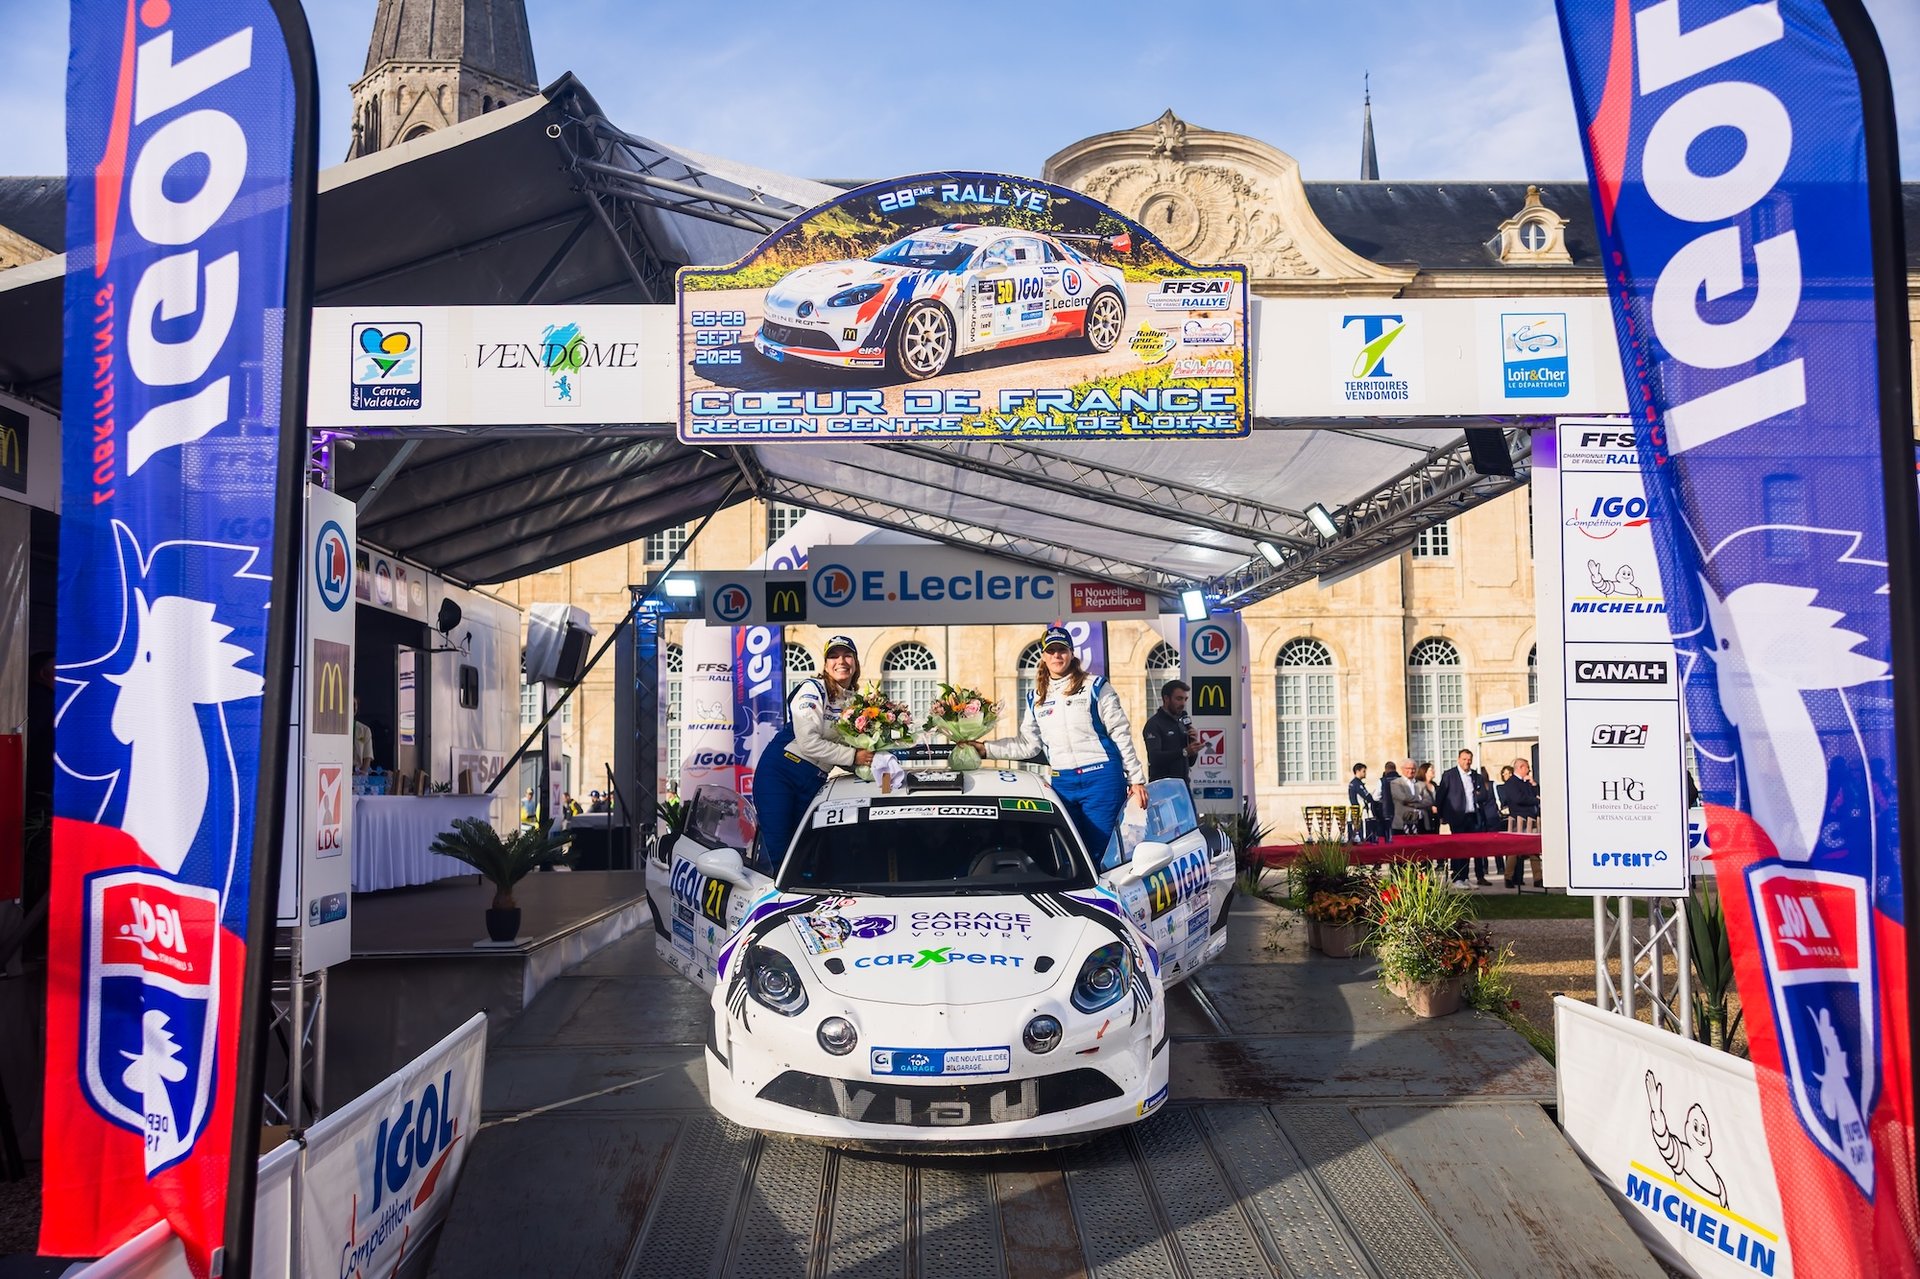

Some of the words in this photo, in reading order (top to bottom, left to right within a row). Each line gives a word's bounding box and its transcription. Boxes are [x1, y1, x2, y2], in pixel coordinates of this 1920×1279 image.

[941, 183, 1049, 213] RALLYE
[997, 279, 1014, 304] 50
[1182, 298, 1226, 306] RALLYE
[692, 311, 745, 327] 26-28
[696, 330, 742, 346] SEPT
[476, 338, 640, 369] VENDÔME
[696, 350, 742, 365] 2025
[1508, 368, 1566, 381] Loir&Cher
[372, 386, 411, 396] Centre-
[1344, 381, 1409, 391] TERRITOIRES
[1518, 381, 1566, 389] DÉPARTEMENT
[364, 397, 380, 407] Val
[380, 397, 393, 407] de
[393, 397, 420, 407] Loire
[692, 390, 887, 415] CŒUR
[904, 390, 980, 414] DE
[999, 388, 1236, 413] FRANCE
[1345, 391, 1409, 401] VENDOMOIS
[693, 417, 818, 433] REGION
[827, 417, 963, 432] CENTRE
[995, 416, 1066, 432] VAL
[1077, 416, 1122, 431] DE
[1131, 415, 1237, 431] LOIRE
[1581, 433, 1637, 448] FFS
[1565, 517, 1622, 529] Compétition
[862, 571, 1054, 600] E.Leclerc
[1074, 588, 1083, 597] la
[1085, 586, 1129, 597] Nouvelle
[1085, 596, 1142, 607] République
[1578, 662, 1665, 681] CANAL+
[939, 807, 996, 816] CANAL+
[1591, 803, 1621, 811] Histoires
[1623, 803, 1633, 811] De
[826, 808, 844, 824] 21
[1593, 853, 1653, 867] LPTENT
[1150, 871, 1171, 913] 21
[1173, 848, 1210, 903] IGOL
[705, 880, 725, 920] 21
[911, 912, 1032, 923] GARAGE
[911, 922, 1032, 933] CORNUT
[912, 931, 1032, 941] VOUVRY
[961, 1054, 992, 1062] NOUVELLE
[1625, 1172, 1776, 1278] MICHELIN
